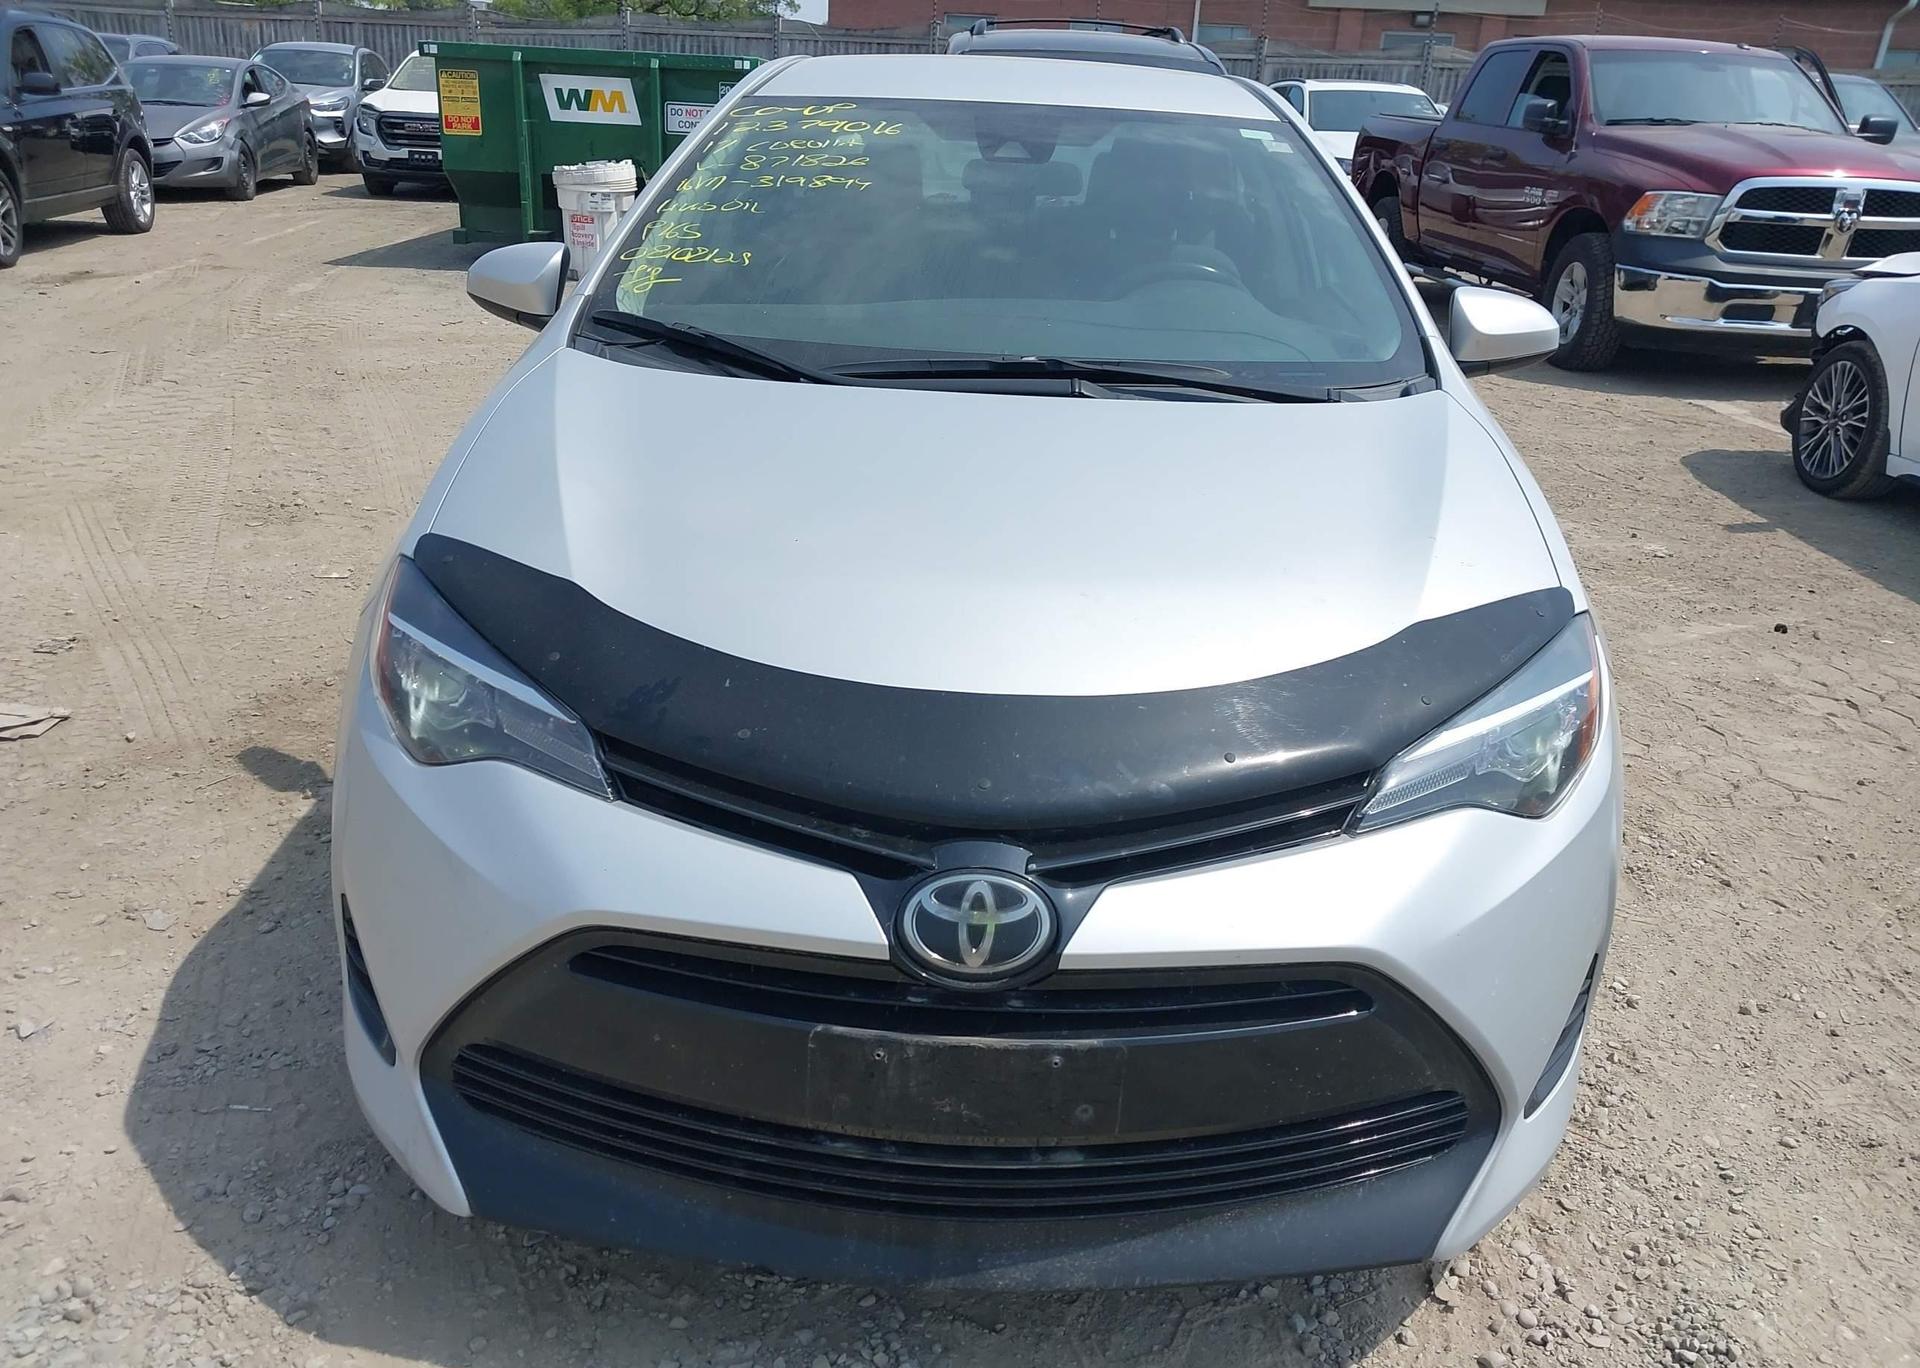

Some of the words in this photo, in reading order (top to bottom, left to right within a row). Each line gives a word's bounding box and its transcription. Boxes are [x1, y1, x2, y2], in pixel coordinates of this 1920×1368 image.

[554, 87, 627, 113] WM
[670, 108, 683, 117] DO
[685, 109, 704, 118] NOT
[572, 215, 593, 223] OTICE
